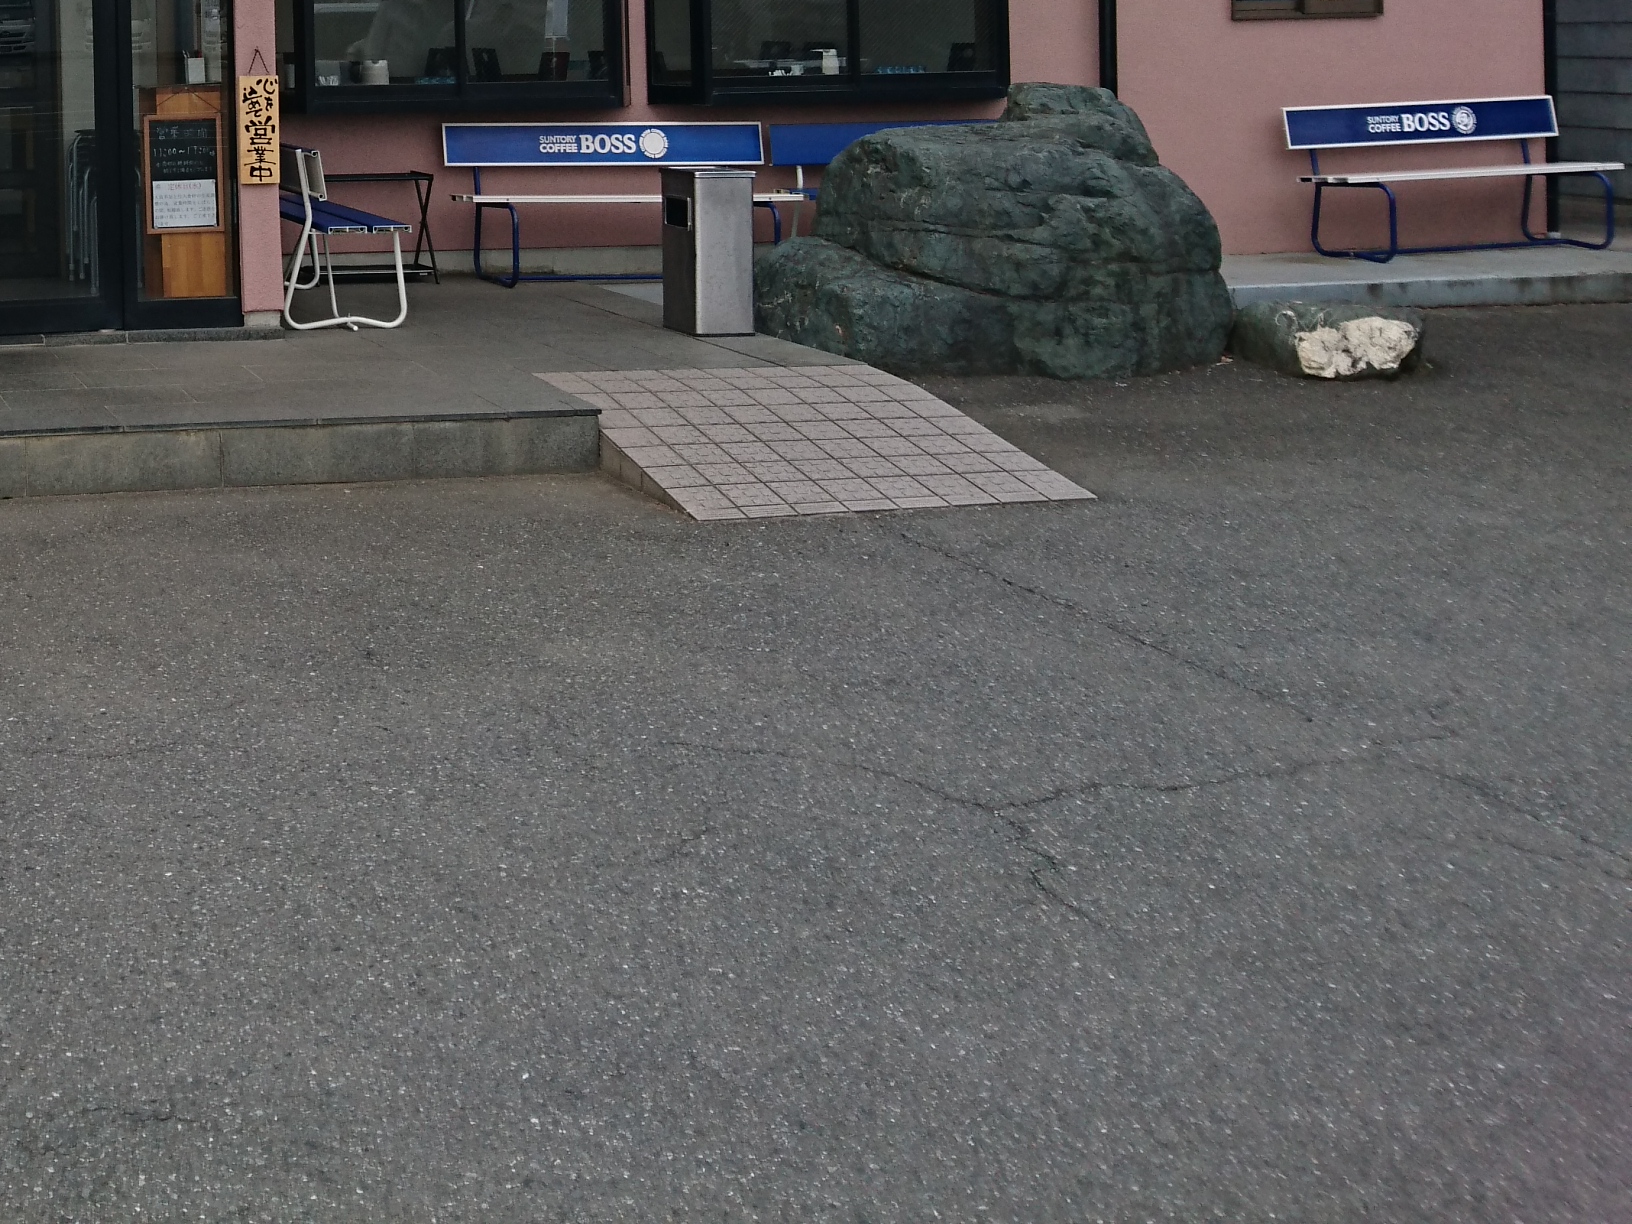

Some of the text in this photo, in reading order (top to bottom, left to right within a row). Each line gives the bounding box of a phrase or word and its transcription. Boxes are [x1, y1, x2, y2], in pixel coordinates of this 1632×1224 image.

[1367, 116, 1399, 124] SUNTORY
[1368, 123, 1401, 133] COFFEE
[1400, 112, 1451, 132] BOSS
[244, 116, 277, 182] 営業中
[539, 135, 577, 143] SUNTORY
[539, 143, 578, 153] COFFEE
[579, 134, 637, 154] BOSS
